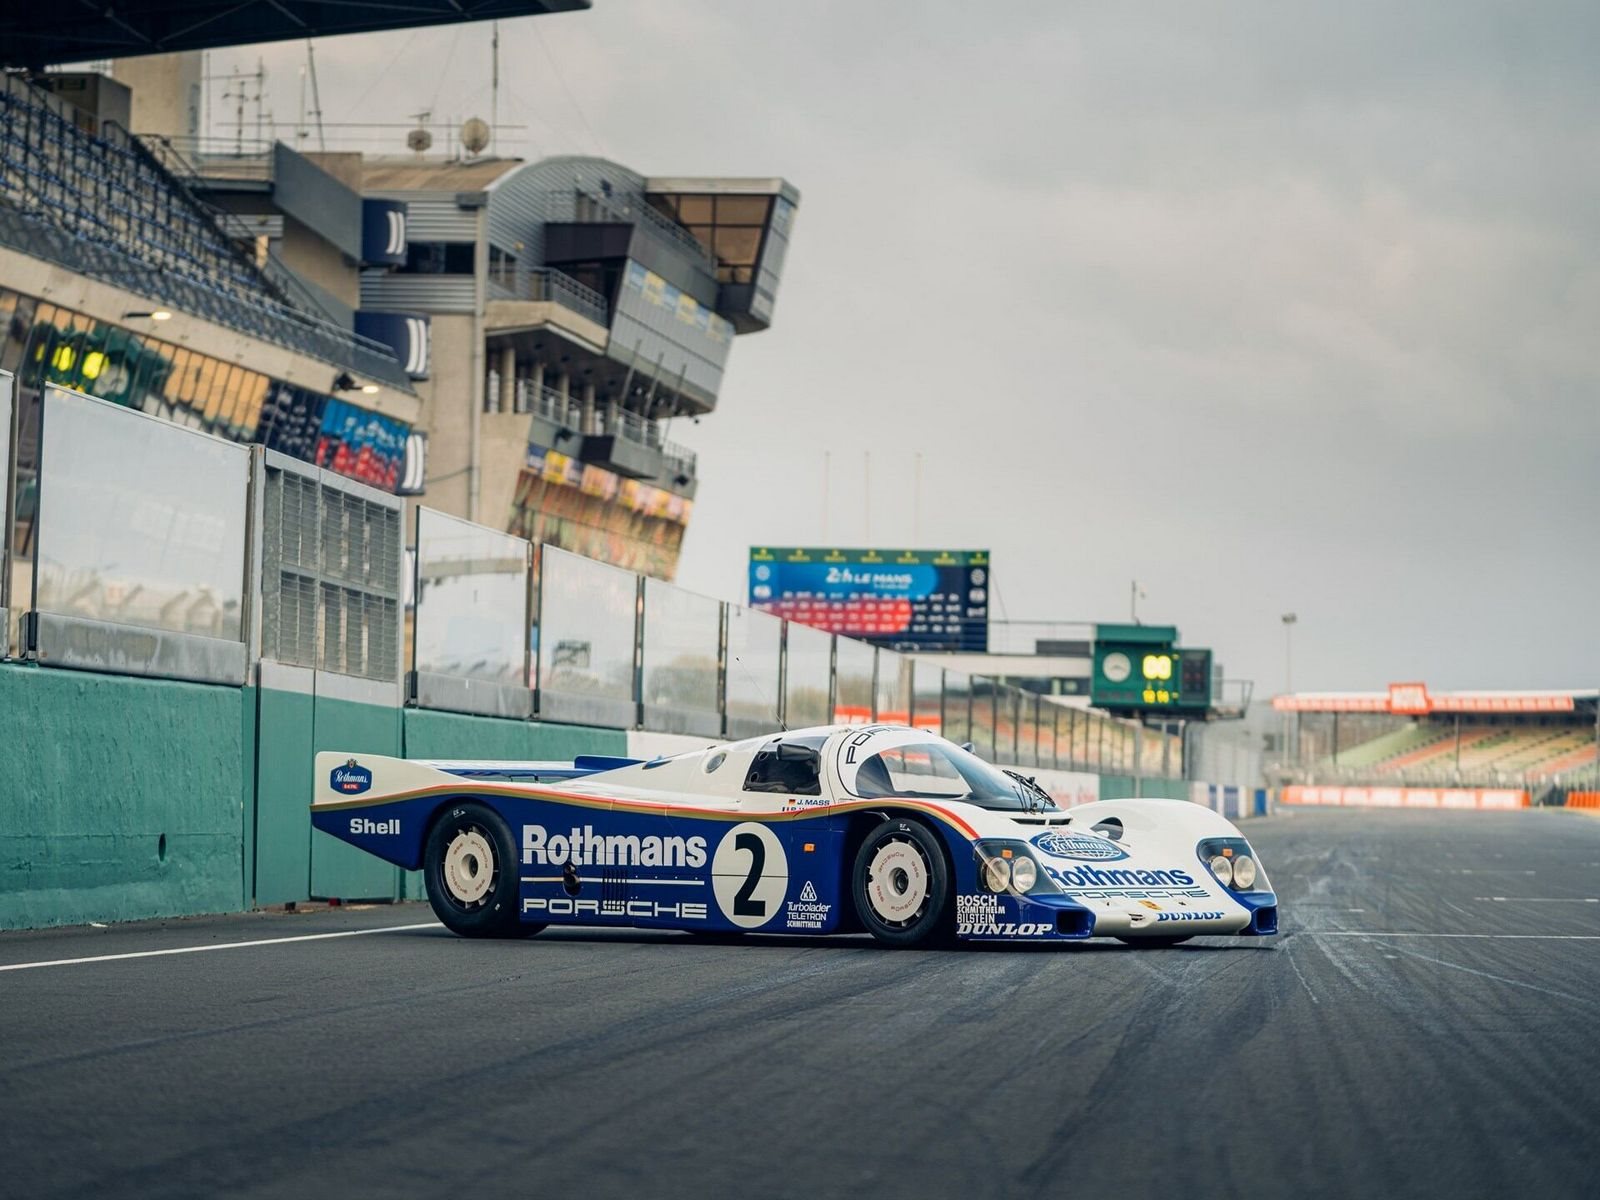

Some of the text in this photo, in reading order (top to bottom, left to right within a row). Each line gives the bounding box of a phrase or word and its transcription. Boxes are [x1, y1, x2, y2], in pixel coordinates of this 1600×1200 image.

[334, 769, 369, 784] Rothmans
[350, 818, 401, 835] Shell
[522, 824, 708, 868] Rothmans
[733, 832, 766, 917] 2
[1045, 864, 1193, 886] Rothmans
[956, 895, 998, 906] BOSCH
[523, 898, 707, 919] PORSCHE
[787, 901, 832, 913] Turbolader
[957, 906, 1006, 914] SCHMITTHELM
[787, 912, 827, 920] TELETRON
[957, 913, 995, 923] BILSTEIN
[1157, 911, 1225, 922] DUNLOP
[956, 923, 1053, 935] DUNLOP
